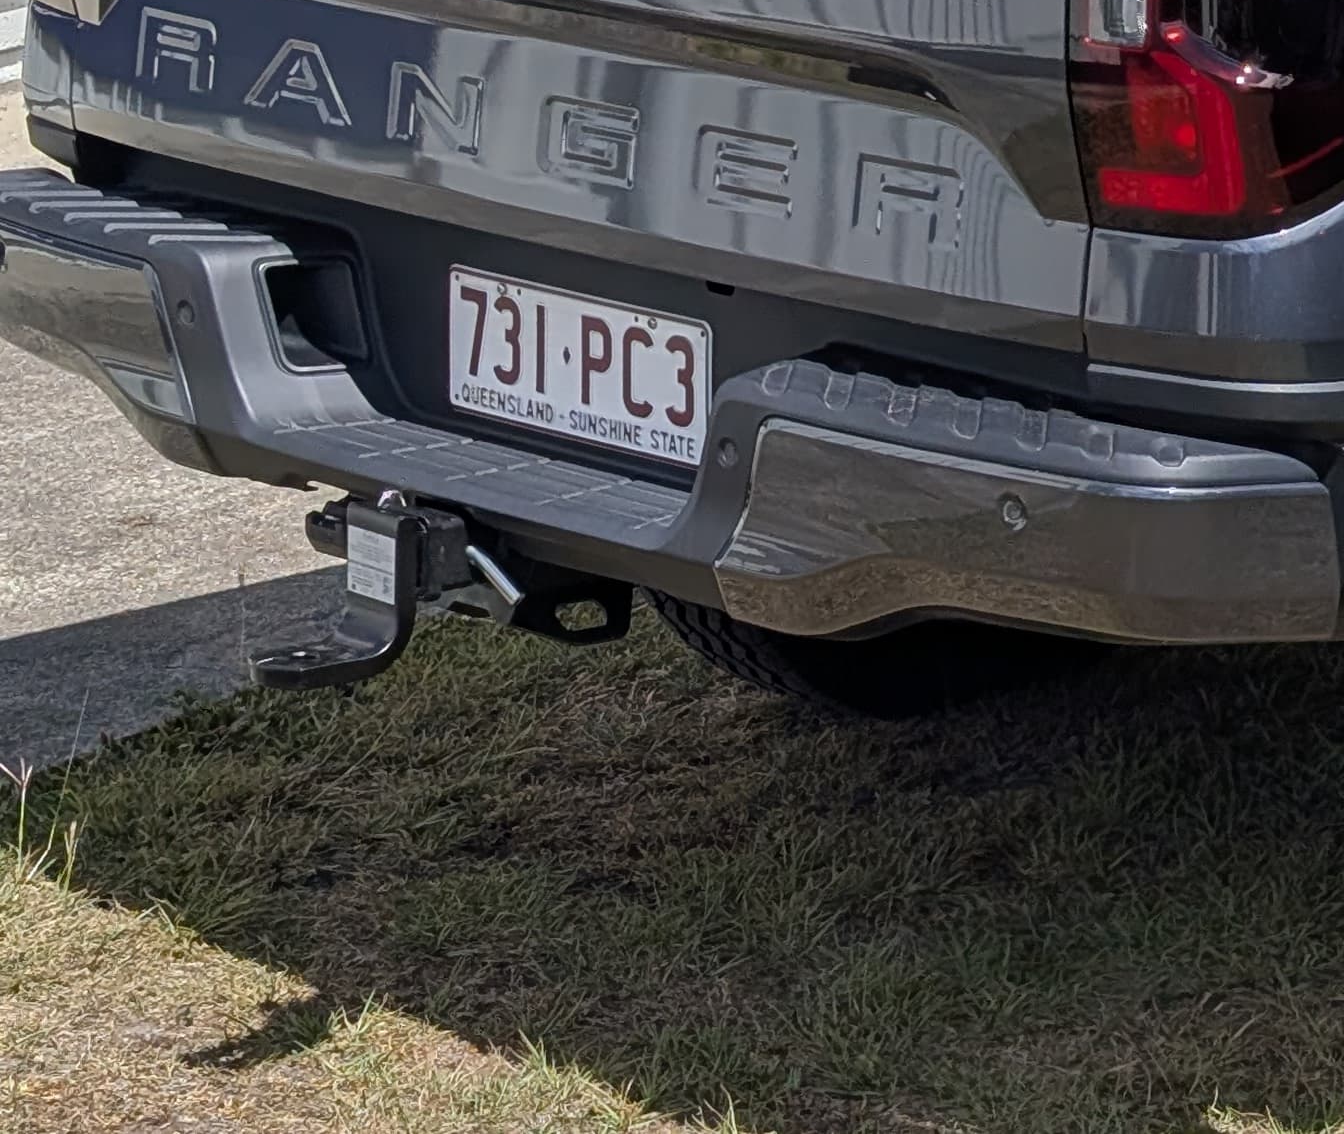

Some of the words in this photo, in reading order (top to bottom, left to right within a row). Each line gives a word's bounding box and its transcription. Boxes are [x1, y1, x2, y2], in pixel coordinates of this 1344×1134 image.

[134, 5, 963, 250] RANGER
[461, 382, 554, 424] QUEENSLAND
[569, 409, 643, 447] SUNSHINE
[650, 429, 697, 459] STATE
